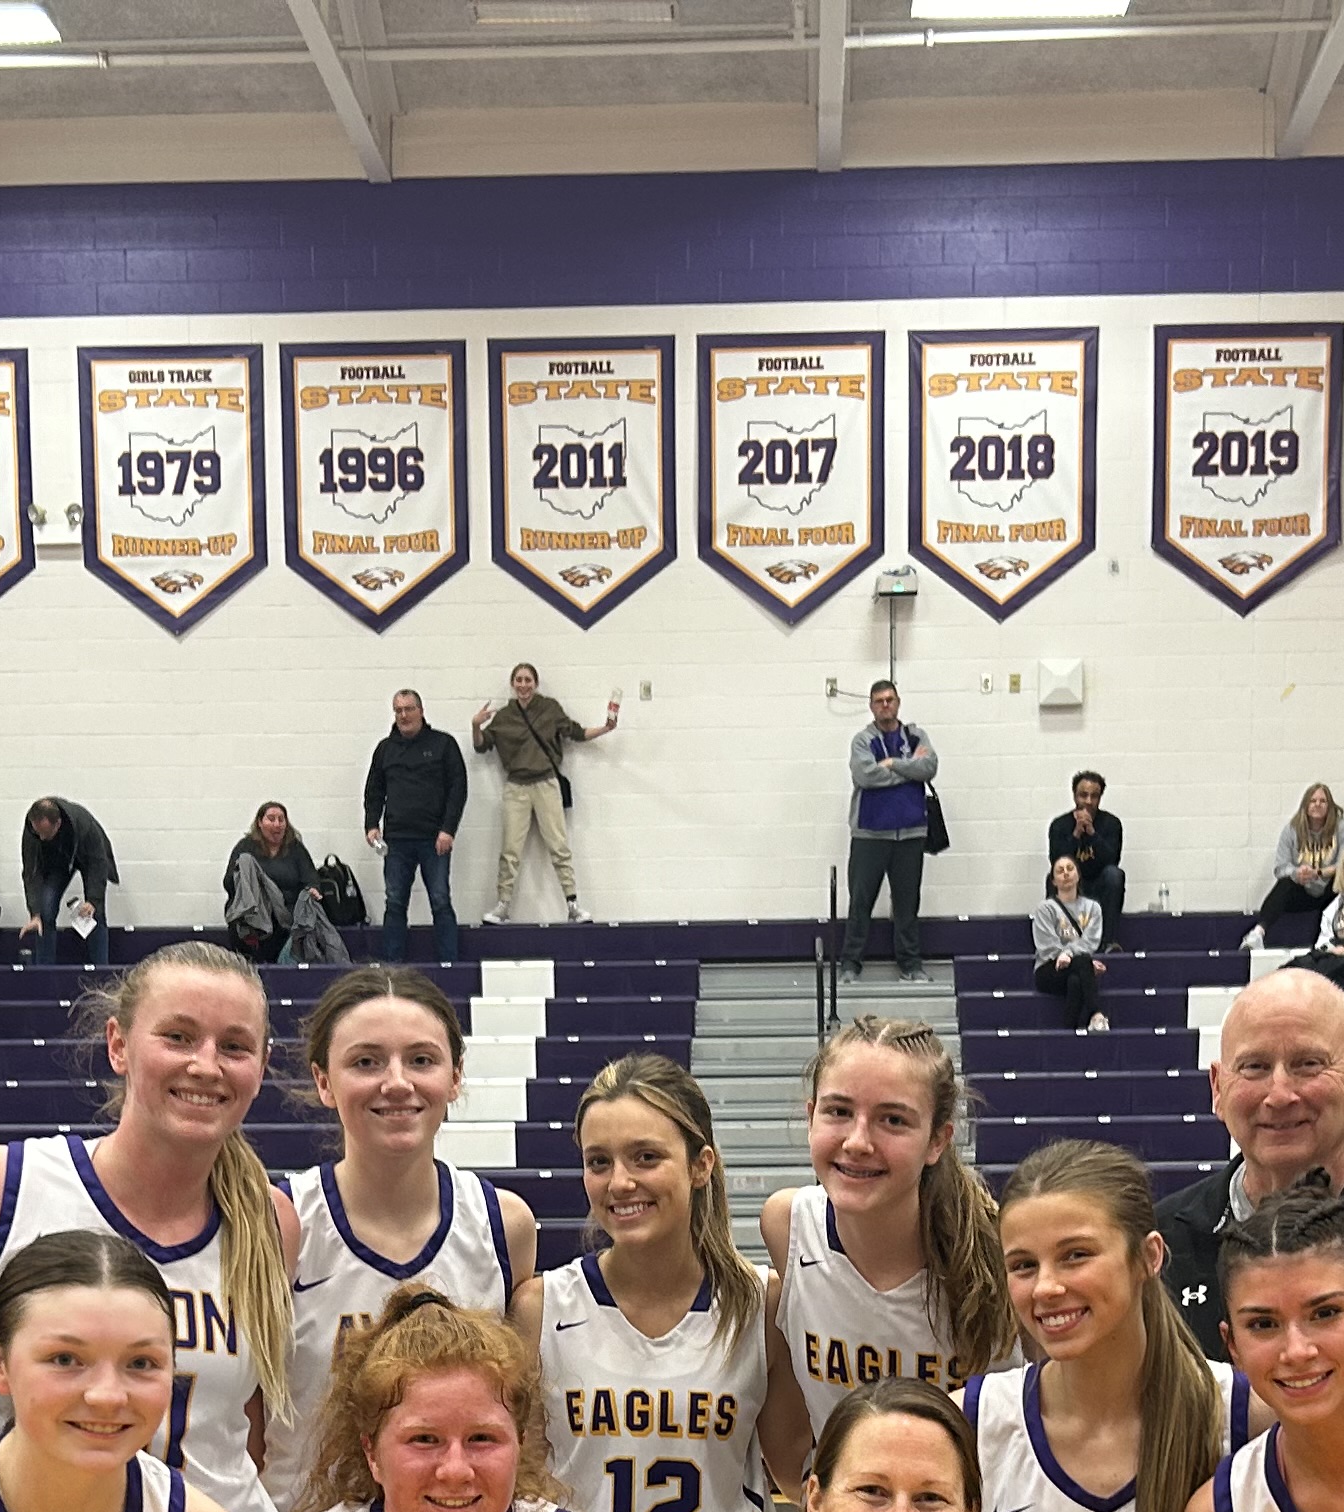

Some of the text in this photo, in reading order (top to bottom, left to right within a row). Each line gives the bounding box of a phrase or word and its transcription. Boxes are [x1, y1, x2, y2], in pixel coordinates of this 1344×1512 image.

[549, 361, 614, 375] FOOTBALL
[758, 356, 824, 372] FOOTBALL
[970, 353, 1036, 367] FOOTBALL
[1215, 348, 1282, 363] FOOTBALL
[128, 369, 212, 384] GIRLS TRACK
[340, 365, 405, 380] FOOTBALL
[928, 371, 1077, 397] STATE
[1173, 366, 1324, 393] STATE
[300, 383, 447, 410] STATE
[508, 379, 656, 406] STATE
[717, 373, 865, 400] STATE
[98, 387, 244, 413] STATE
[533, 442, 627, 490] 2011
[738, 438, 837, 485] 2017
[950, 434, 1055, 481] 2018
[1192, 430, 1299, 477] 2019
[118, 451, 221, 496] 1979
[319, 443, 424, 494] 1996
[520, 526, 647, 551] RUNNER-UP
[726, 521, 855, 547] FINAL FOUR
[937, 519, 1067, 544] FINAL FOUR
[1179, 513, 1311, 539] FINAL FOUR
[112, 532, 237, 557] RUNNER-UP
[312, 529, 440, 554] FINAL FOUR
[566, 1389, 738, 1439] EAGLES
